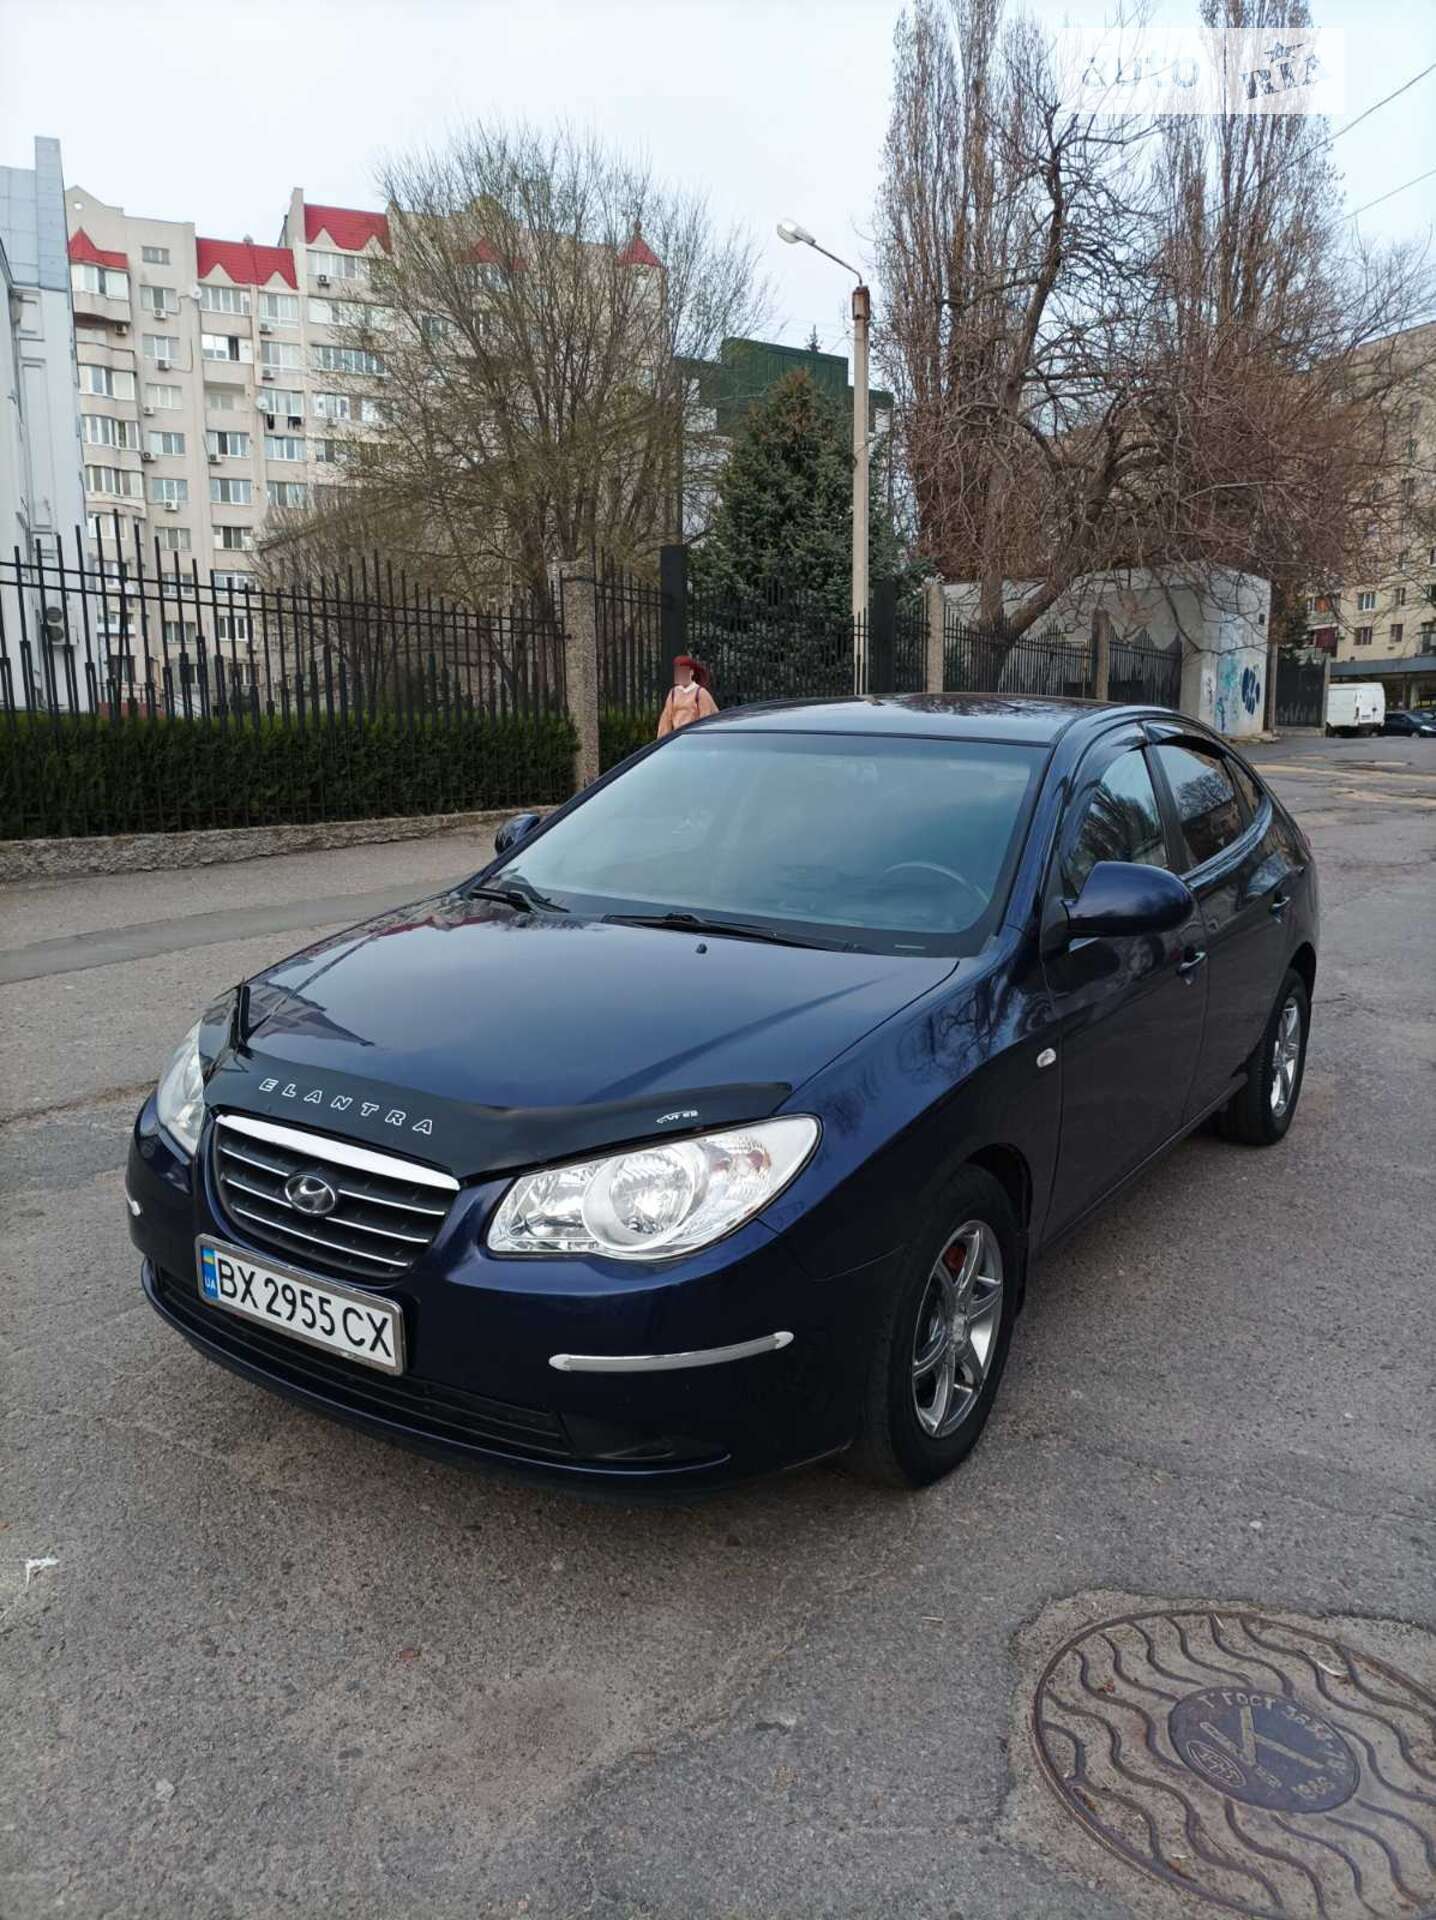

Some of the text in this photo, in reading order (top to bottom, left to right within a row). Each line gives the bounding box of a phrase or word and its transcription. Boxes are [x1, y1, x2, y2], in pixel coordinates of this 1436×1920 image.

[258, 1077, 433, 1135] ELANTRA
[204, 1277, 216, 1290] UA
[217, 1258, 392, 1358] BX 2955 CX
